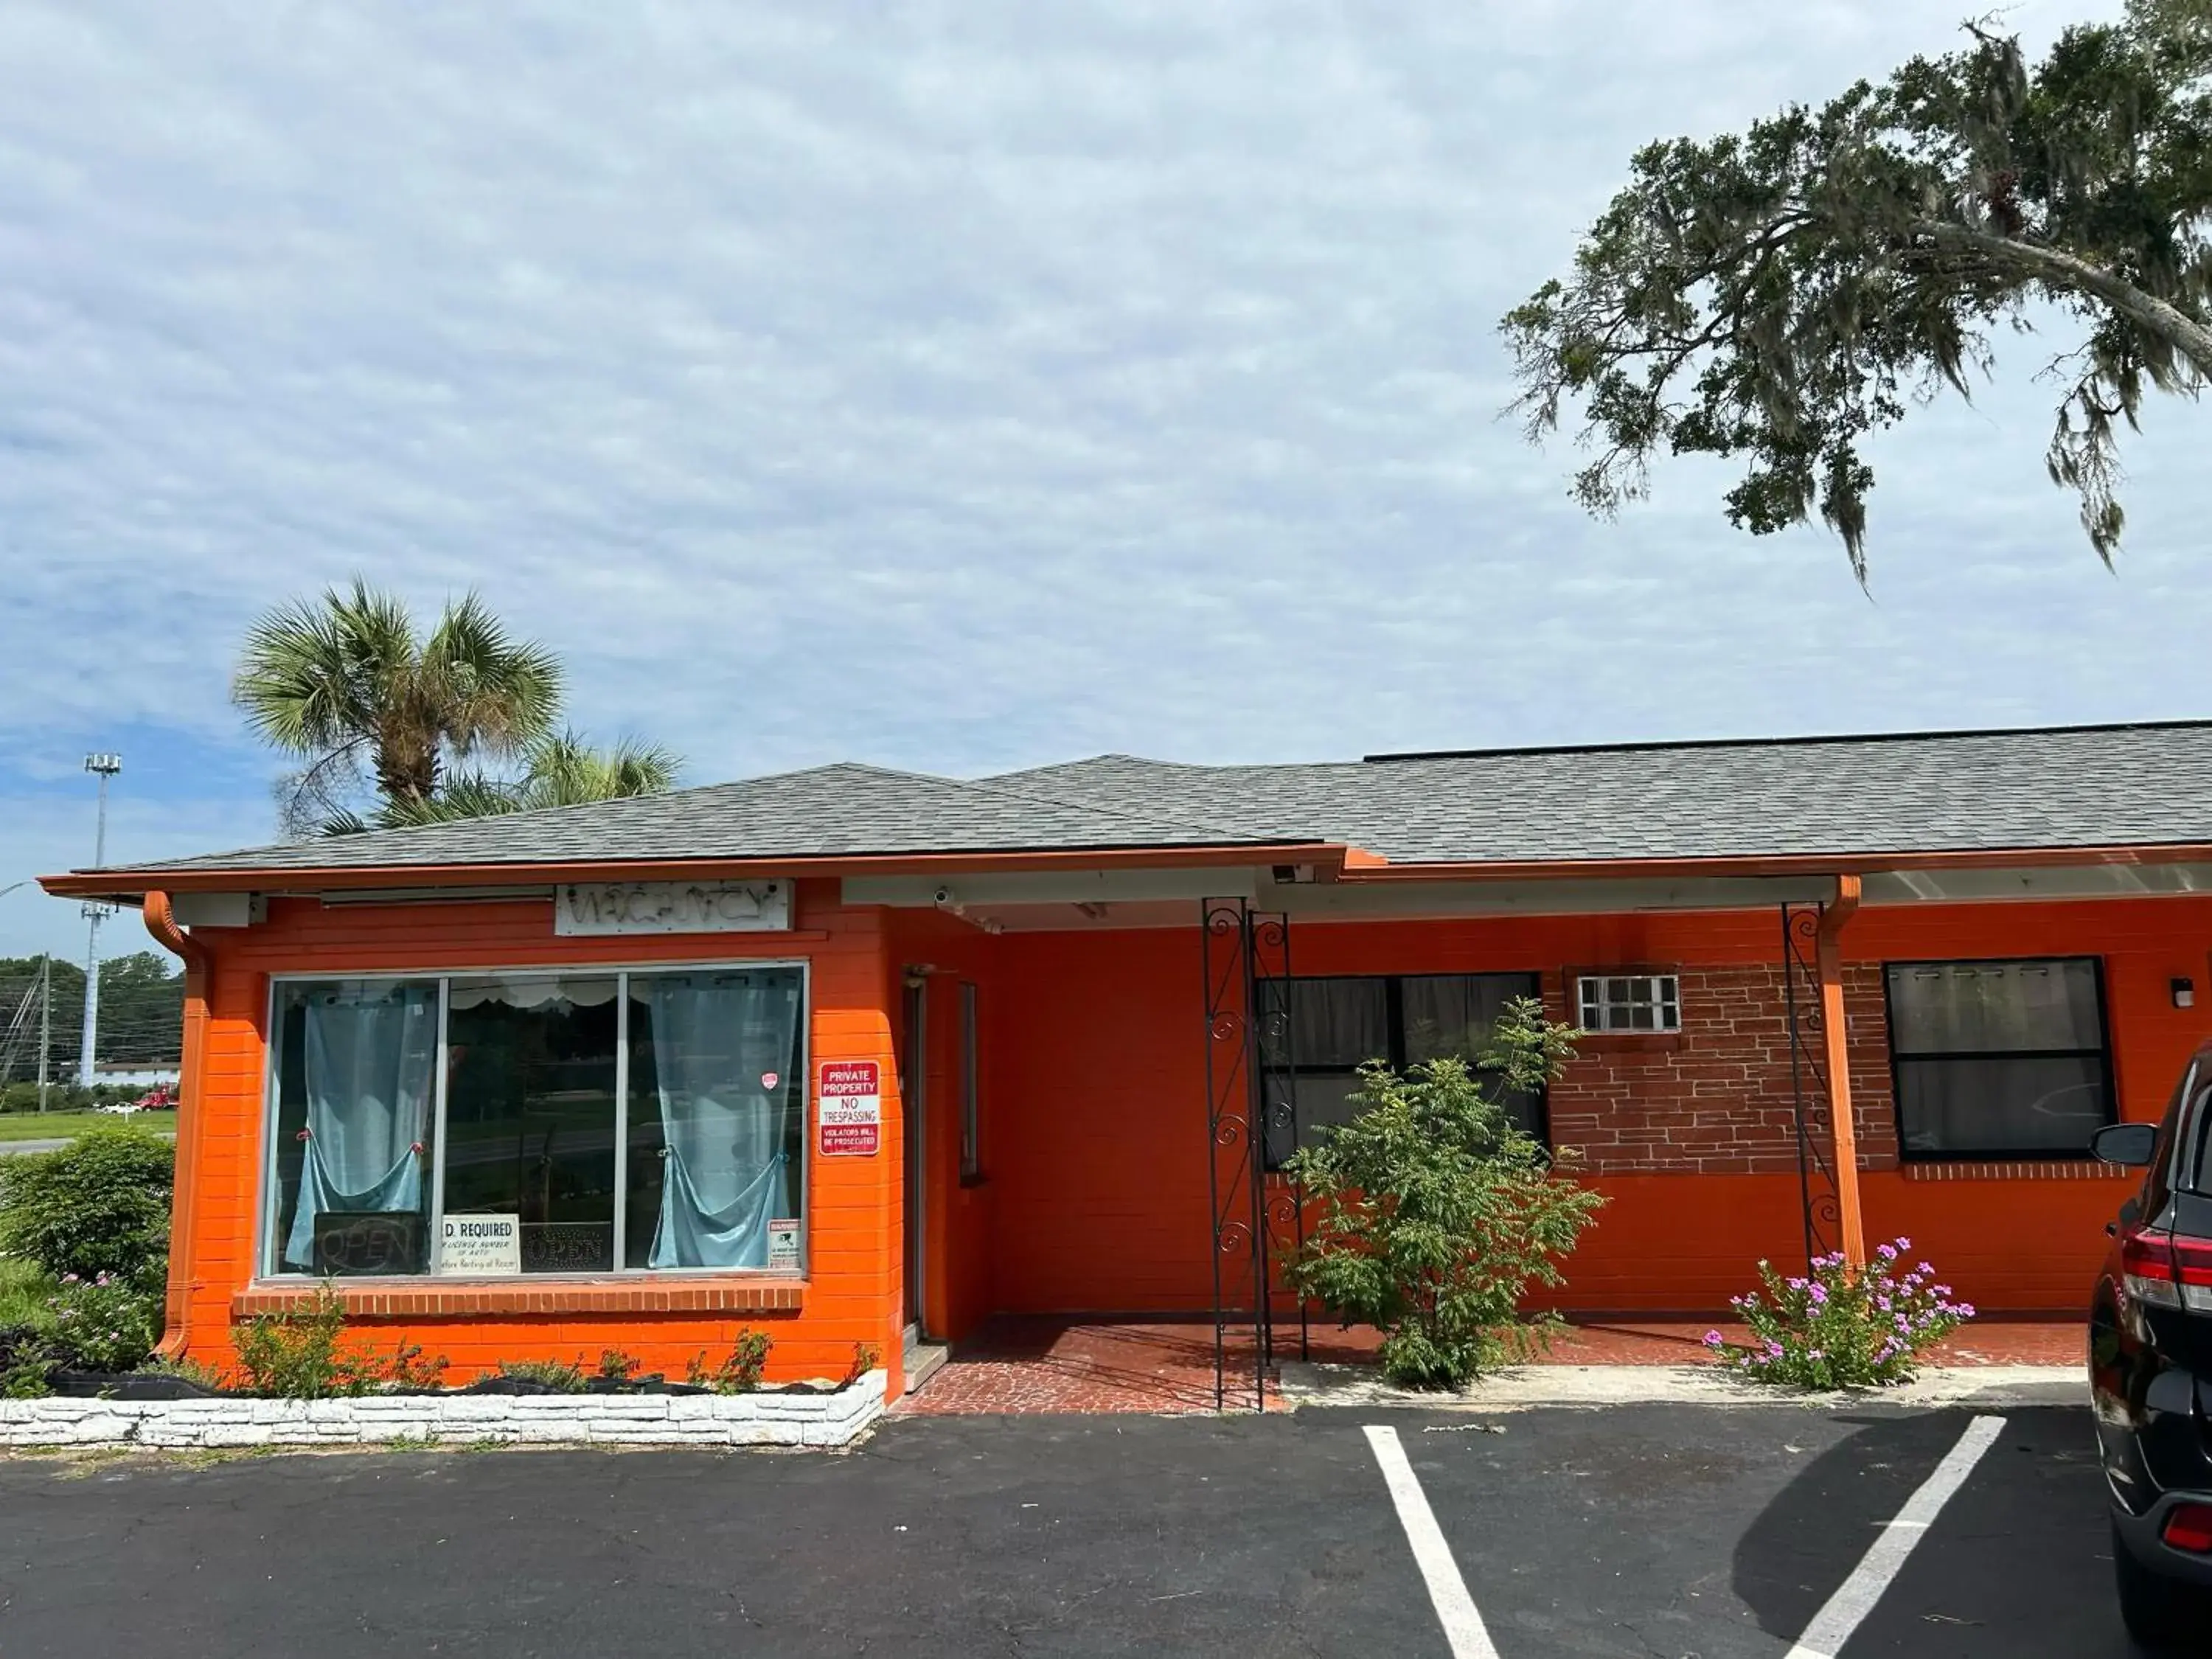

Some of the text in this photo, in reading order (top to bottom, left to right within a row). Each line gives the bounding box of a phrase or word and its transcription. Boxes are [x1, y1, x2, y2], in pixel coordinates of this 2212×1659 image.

[830, 1071, 870, 1082] PRIVATE
[823, 1082, 875, 1093] PROPERTY
[841, 1097, 858, 1109] NO
[824, 1110, 876, 1123] TRESPASSING
[824, 1128, 859, 1137] VIOLATORS
[461, 1222, 512, 1237] REQUIRED
[321, 1229, 411, 1262] OPEN
